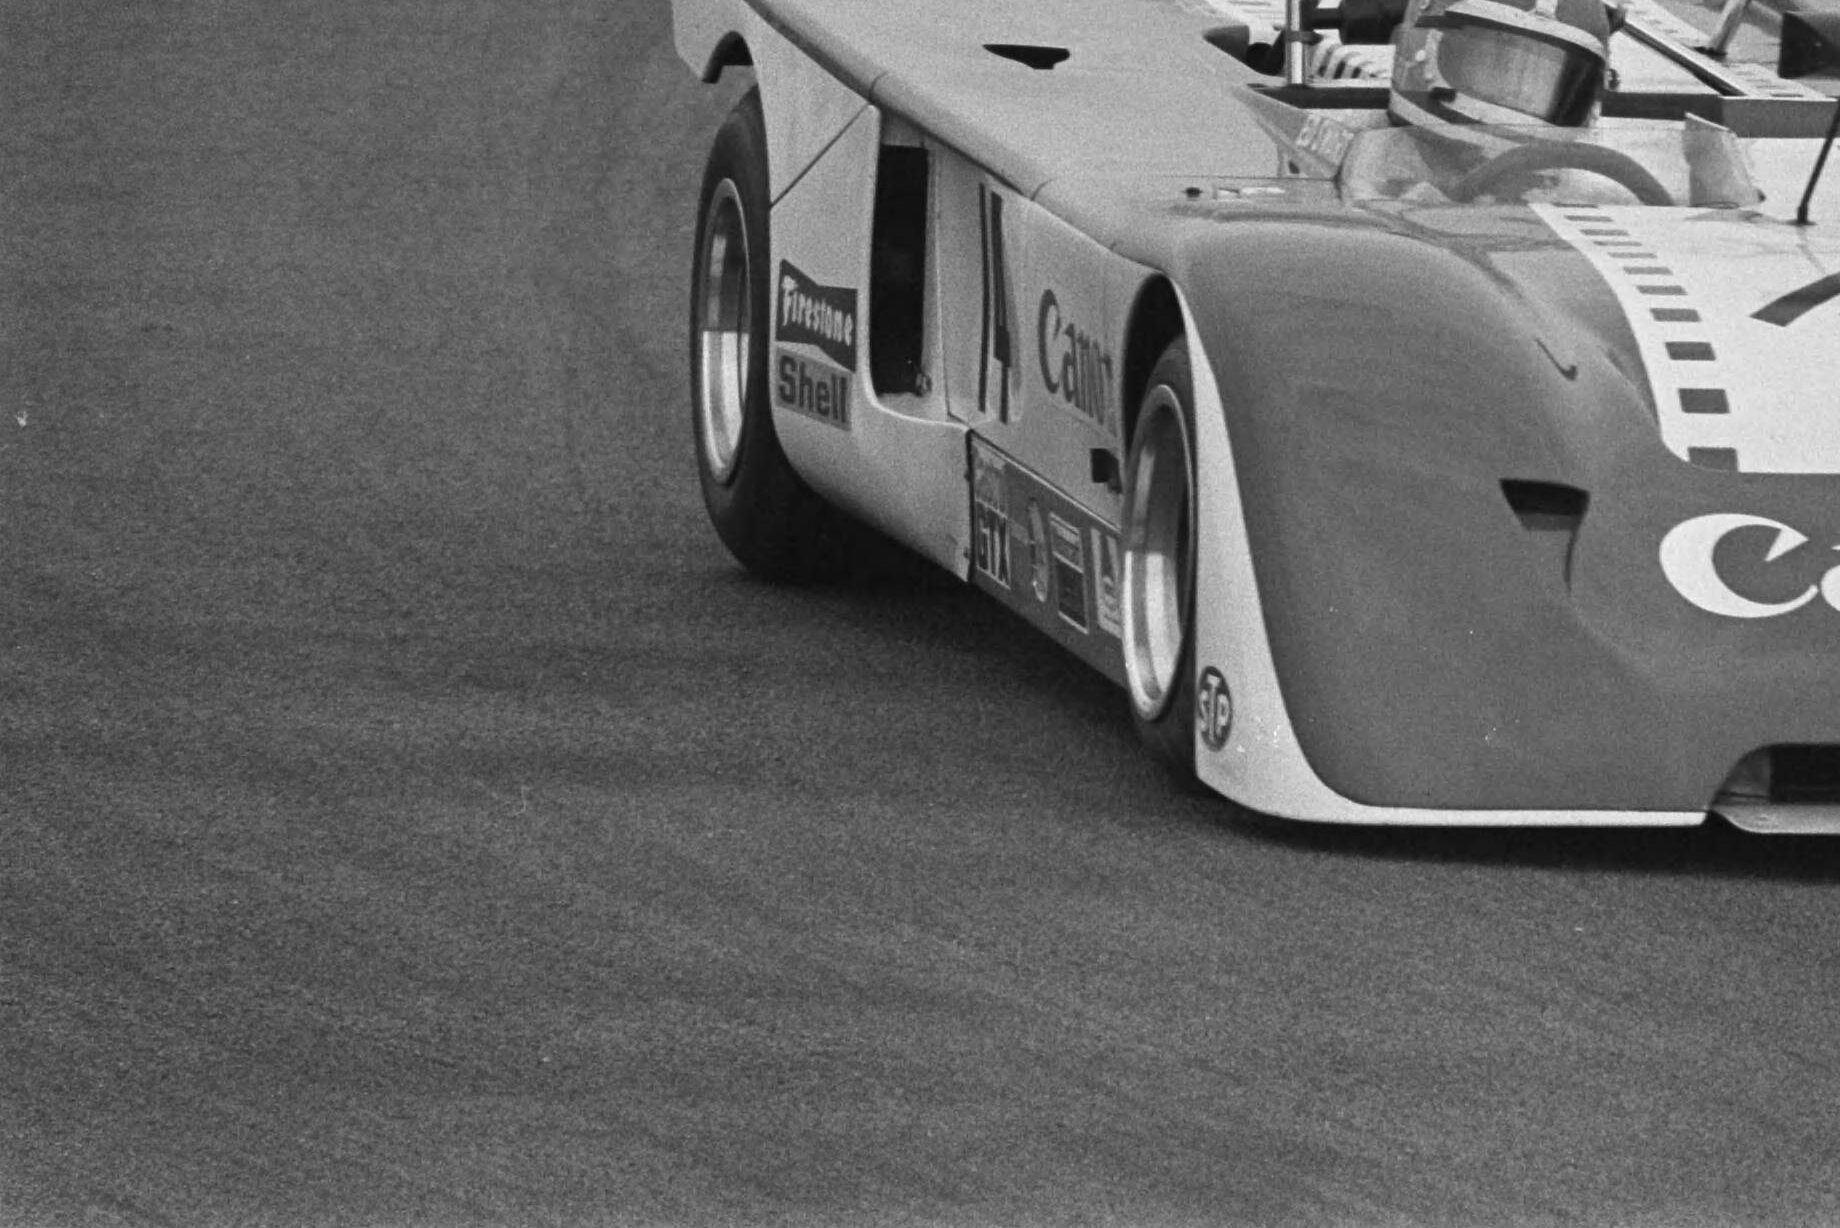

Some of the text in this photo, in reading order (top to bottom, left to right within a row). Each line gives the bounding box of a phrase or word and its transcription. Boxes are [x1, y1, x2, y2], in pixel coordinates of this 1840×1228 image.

[781, 274, 854, 348] Firestone
[778, 354, 848, 424] Shell
[1198, 673, 1230, 744] STP
